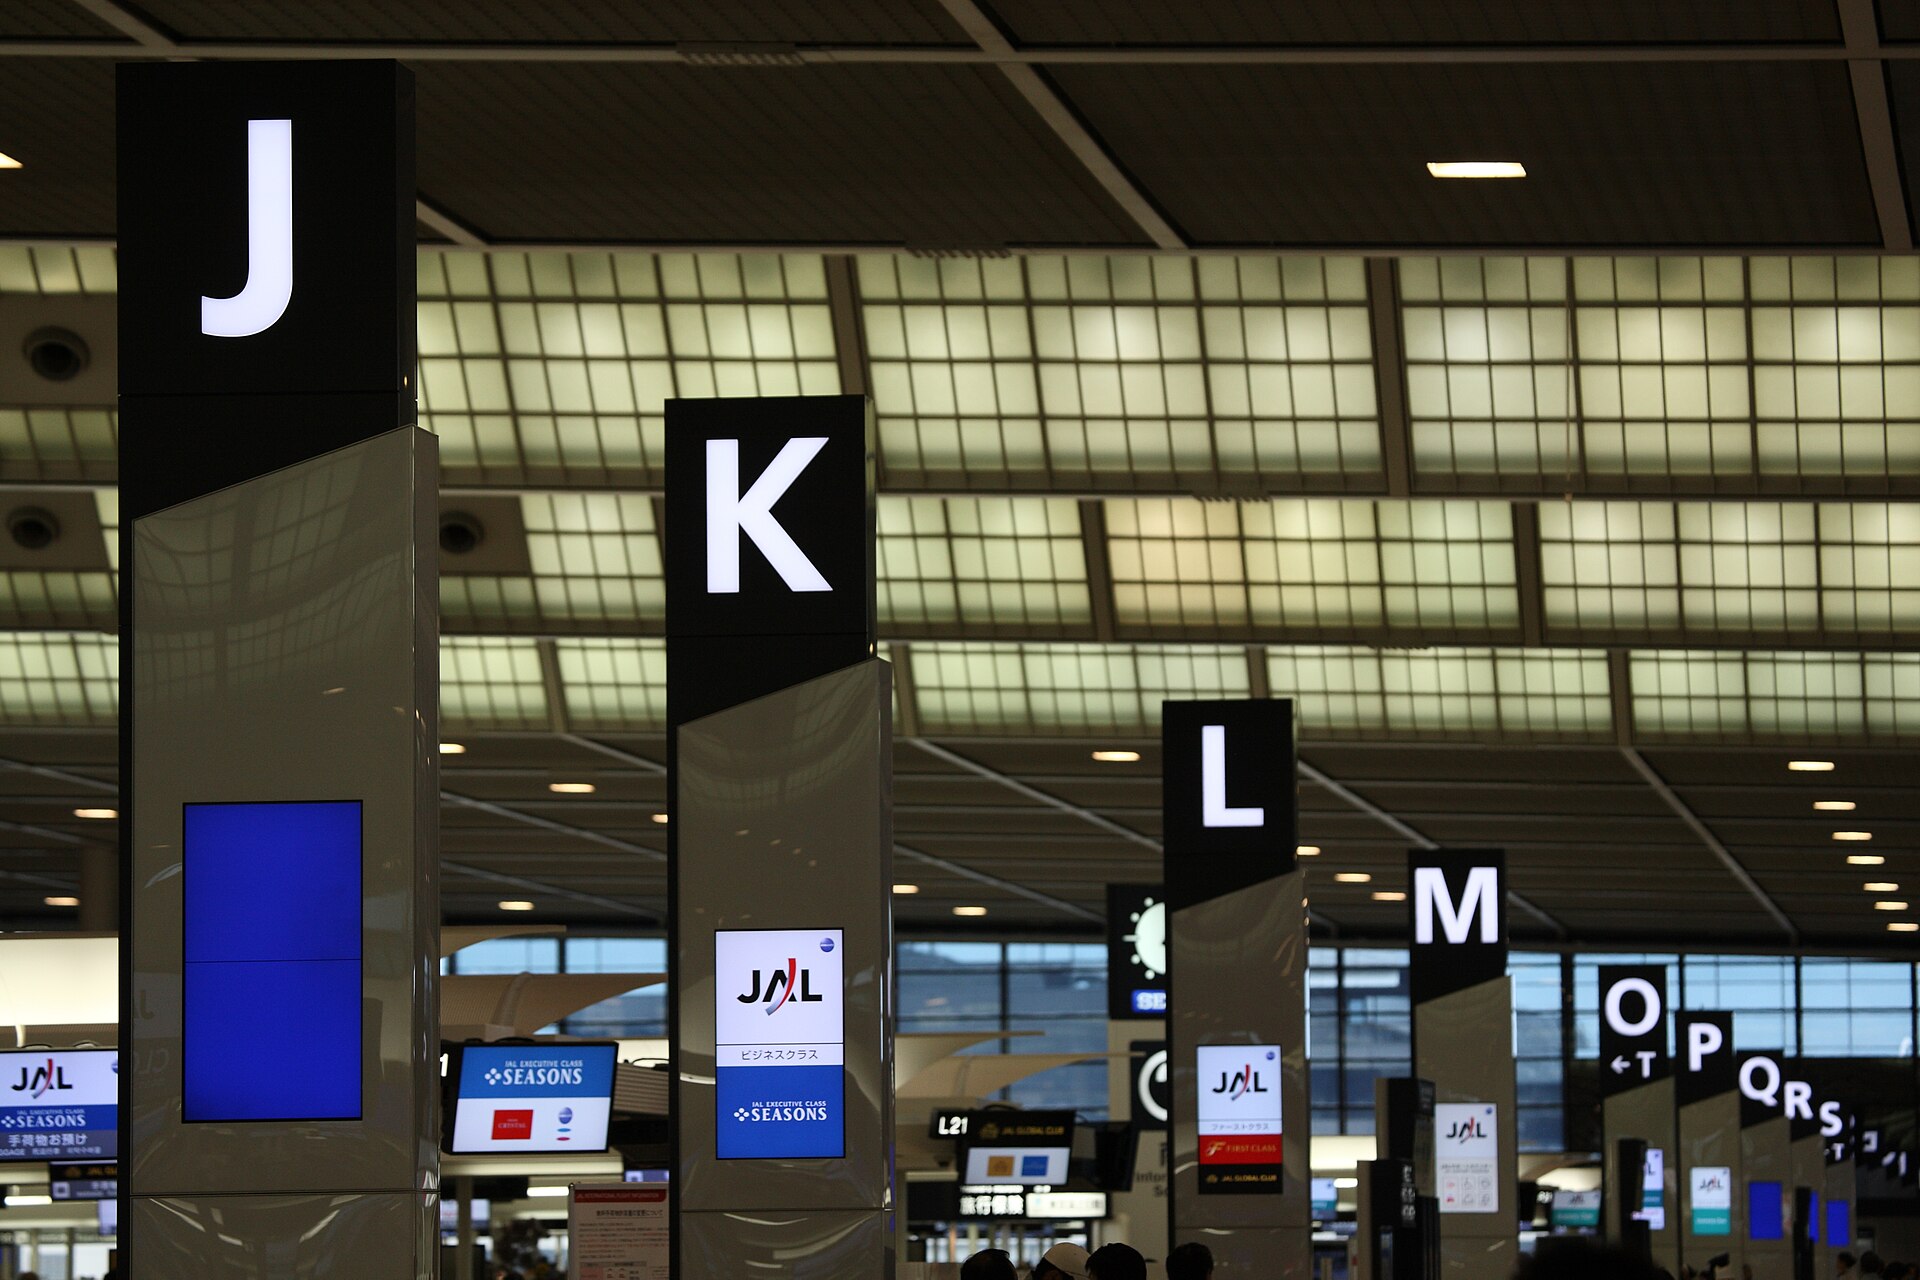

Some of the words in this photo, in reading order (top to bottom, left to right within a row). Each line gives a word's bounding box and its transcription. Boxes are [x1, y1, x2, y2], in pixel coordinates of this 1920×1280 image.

[202, 120, 293, 337] J
[706, 437, 833, 593] K
[1202, 726, 1264, 827] L
[1415, 867, 1498, 943] M
[737, 958, 823, 1016] JAL
[1605, 978, 1660, 1036] O
[519, 1060, 558, 1068] EXECUTIVE
[560, 1059, 584, 1067] CLASS
[741, 1050, 818, 1061] ビジネスクラス
[1637, 1052, 1656, 1077] T
[1689, 1023, 1722, 1071] P
[11, 1058, 74, 1099] JAL
[502, 1068, 583, 1085] SEASONS
[1212, 1064, 1268, 1101] JAL
[1739, 1057, 1780, 1106] Q
[751, 1107, 828, 1121] SEASONS
[1784, 1081, 1813, 1119] R
[16, 1114, 87, 1128] SEASONS
[939, 1117, 968, 1134] L21
[1446, 1116, 1488, 1144] JAL
[1820, 1102, 1842, 1136] S
[1832, 1143, 1845, 1160] T
